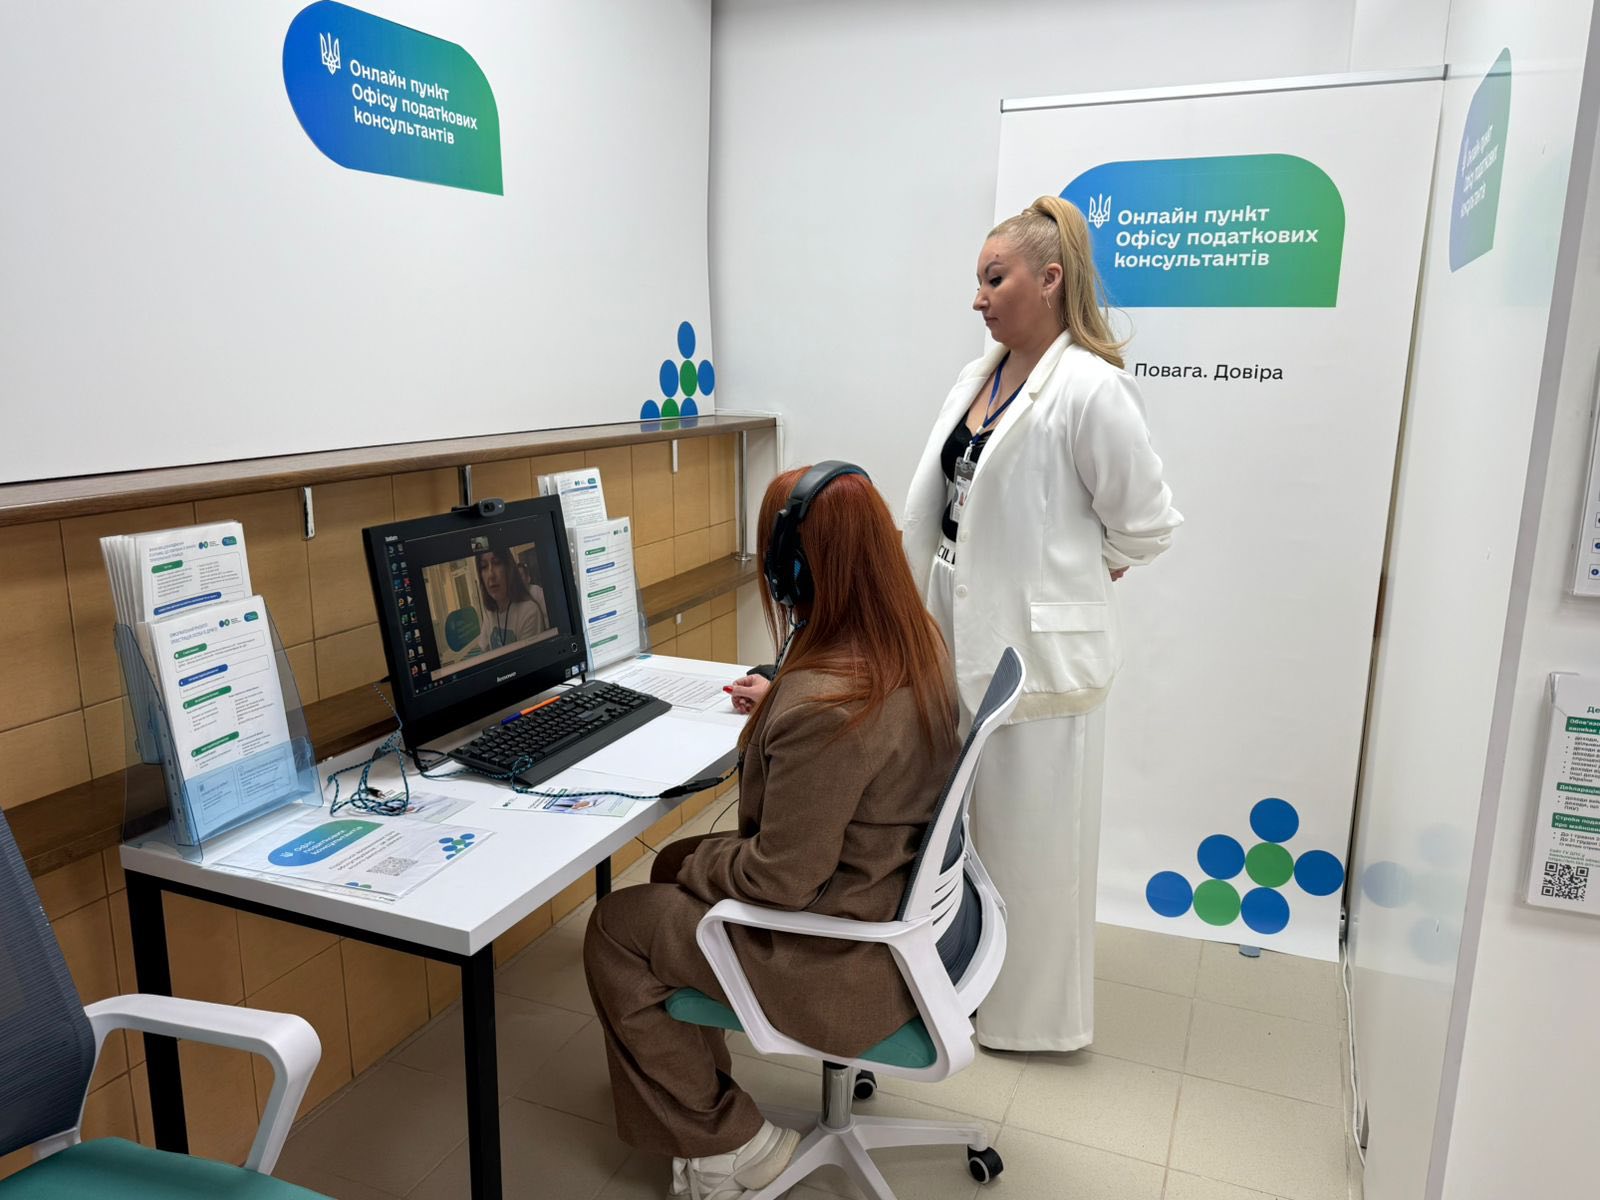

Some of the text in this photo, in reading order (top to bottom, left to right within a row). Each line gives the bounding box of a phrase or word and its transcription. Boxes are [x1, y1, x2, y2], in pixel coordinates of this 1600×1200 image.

[350, 59, 449, 102] Онлайн пункт
[352, 84, 478, 130] Офісу податкових
[353, 106, 455, 144] консультантів
[1118, 205, 1270, 227] Онлайн пункт
[1115, 227, 1319, 250] Офісу податкових
[1114, 250, 1270, 271] консультантів
[1135, 363, 1284, 382] Повага. Довіра
[1555, 815, 1580, 823] Строки
